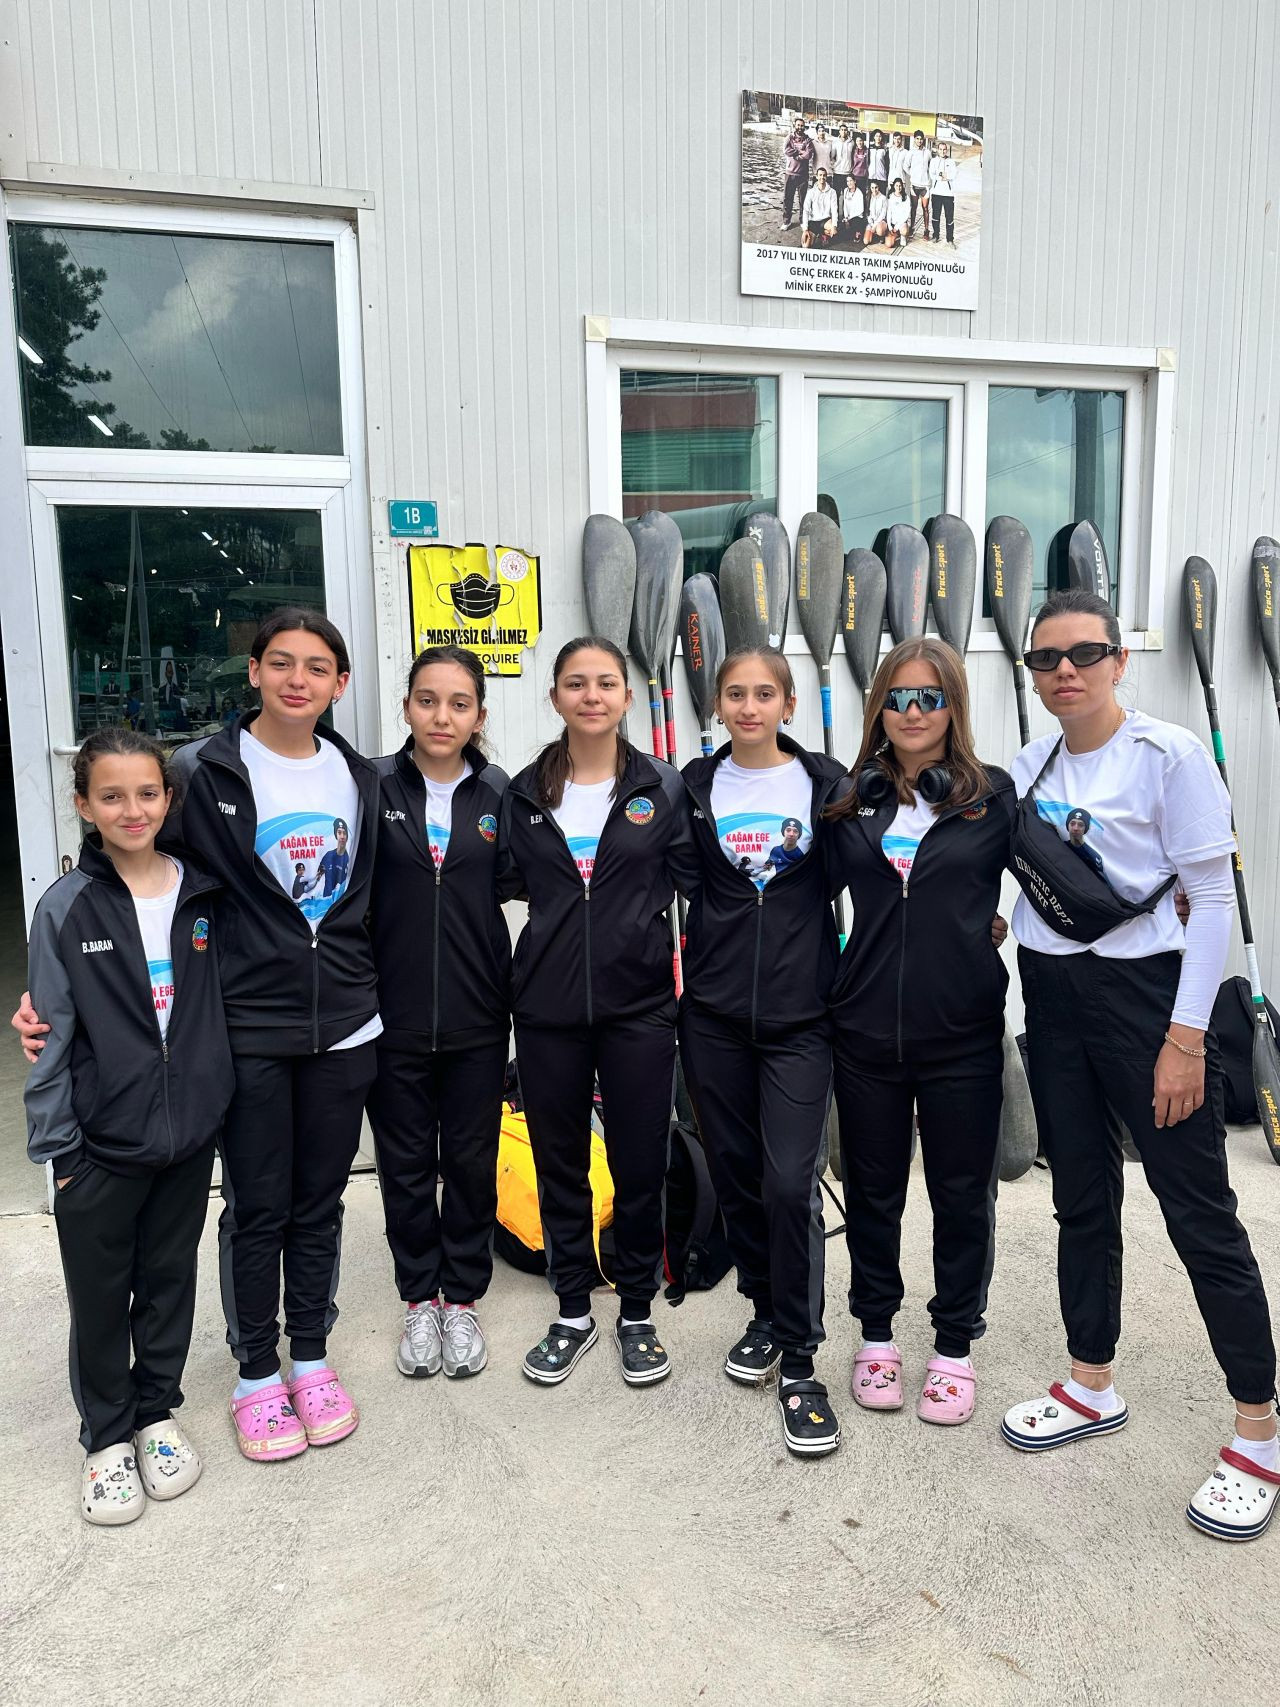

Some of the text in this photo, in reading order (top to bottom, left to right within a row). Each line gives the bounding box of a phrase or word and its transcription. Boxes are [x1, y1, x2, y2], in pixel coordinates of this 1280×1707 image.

[756, 248, 966, 274] 2017 YILI YILDIZ KIZLAR TAKIM ŞAMPİYONLUĞU
[789, 266, 815, 279] GENÇ
[817, 268, 846, 280] ERKEK
[847, 271, 853, 280] 4
[861, 272, 933, 286] ŞAMPİYONLUĞU
[785, 280, 813, 292] MİNİK
[815, 283, 844, 294] ERKEK
[846, 285, 857, 295] 2X
[865, 287, 937, 301] ŞAMPİYONLUĞU
[404, 507, 420, 524] 1B
[1093, 538, 1105, 600] VORTE
[280, 836, 324, 849] KAĞAN EGE
[725, 832, 770, 843] KAĞAN EGE
[290, 849, 316, 860] BARAN
[735, 844, 762, 853] BARAN
[1015, 854, 1051, 897] ATHLETIC
[82, 940, 114, 954] B.BARAN
